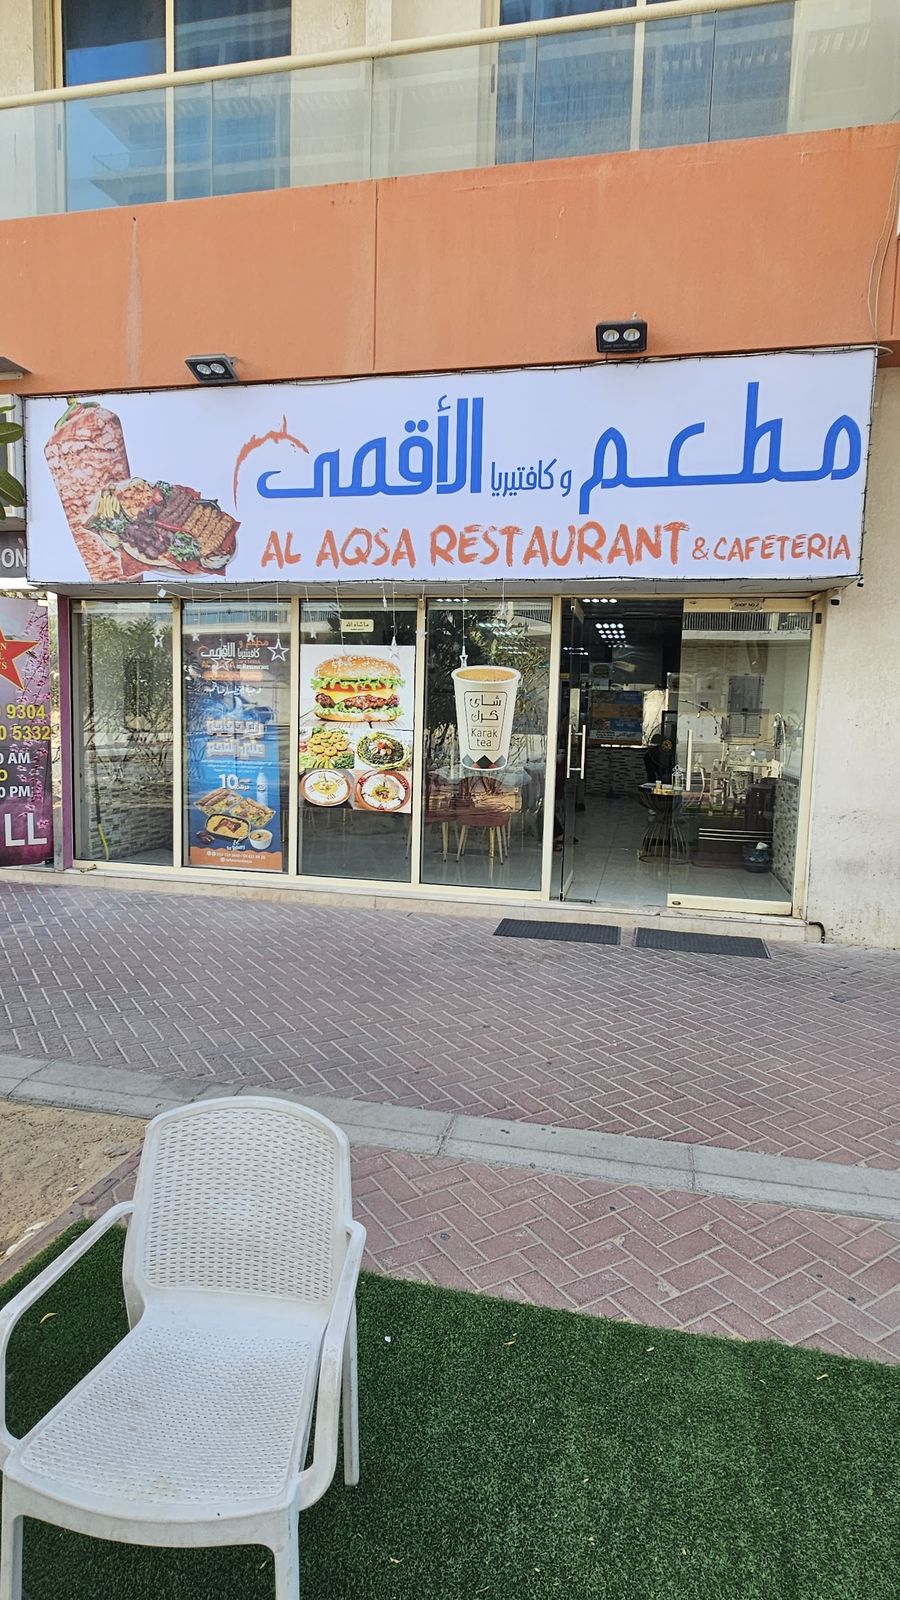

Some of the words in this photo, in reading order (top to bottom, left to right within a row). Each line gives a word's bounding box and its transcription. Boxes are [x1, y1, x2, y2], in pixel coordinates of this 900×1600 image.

[256, 394, 484, 499] الأقصى
[579, 381, 862, 515] مطعم
[261, 529, 301, 569] AL
[316, 526, 416, 569] AQSA
[430, 520, 690, 569] RESTAURANT
[692, 536, 709, 561] &
[713, 532, 851, 563] CAFETERIA
[7, 704, 46, 720] 9304
[12, 725, 51, 741] 5332
[471, 727, 499, 739] Karak
[476, 739, 492, 747] tea
[8, 752, 31, 765] AM
[219, 773, 239, 789] 10
[9, 785, 32, 798] PM
